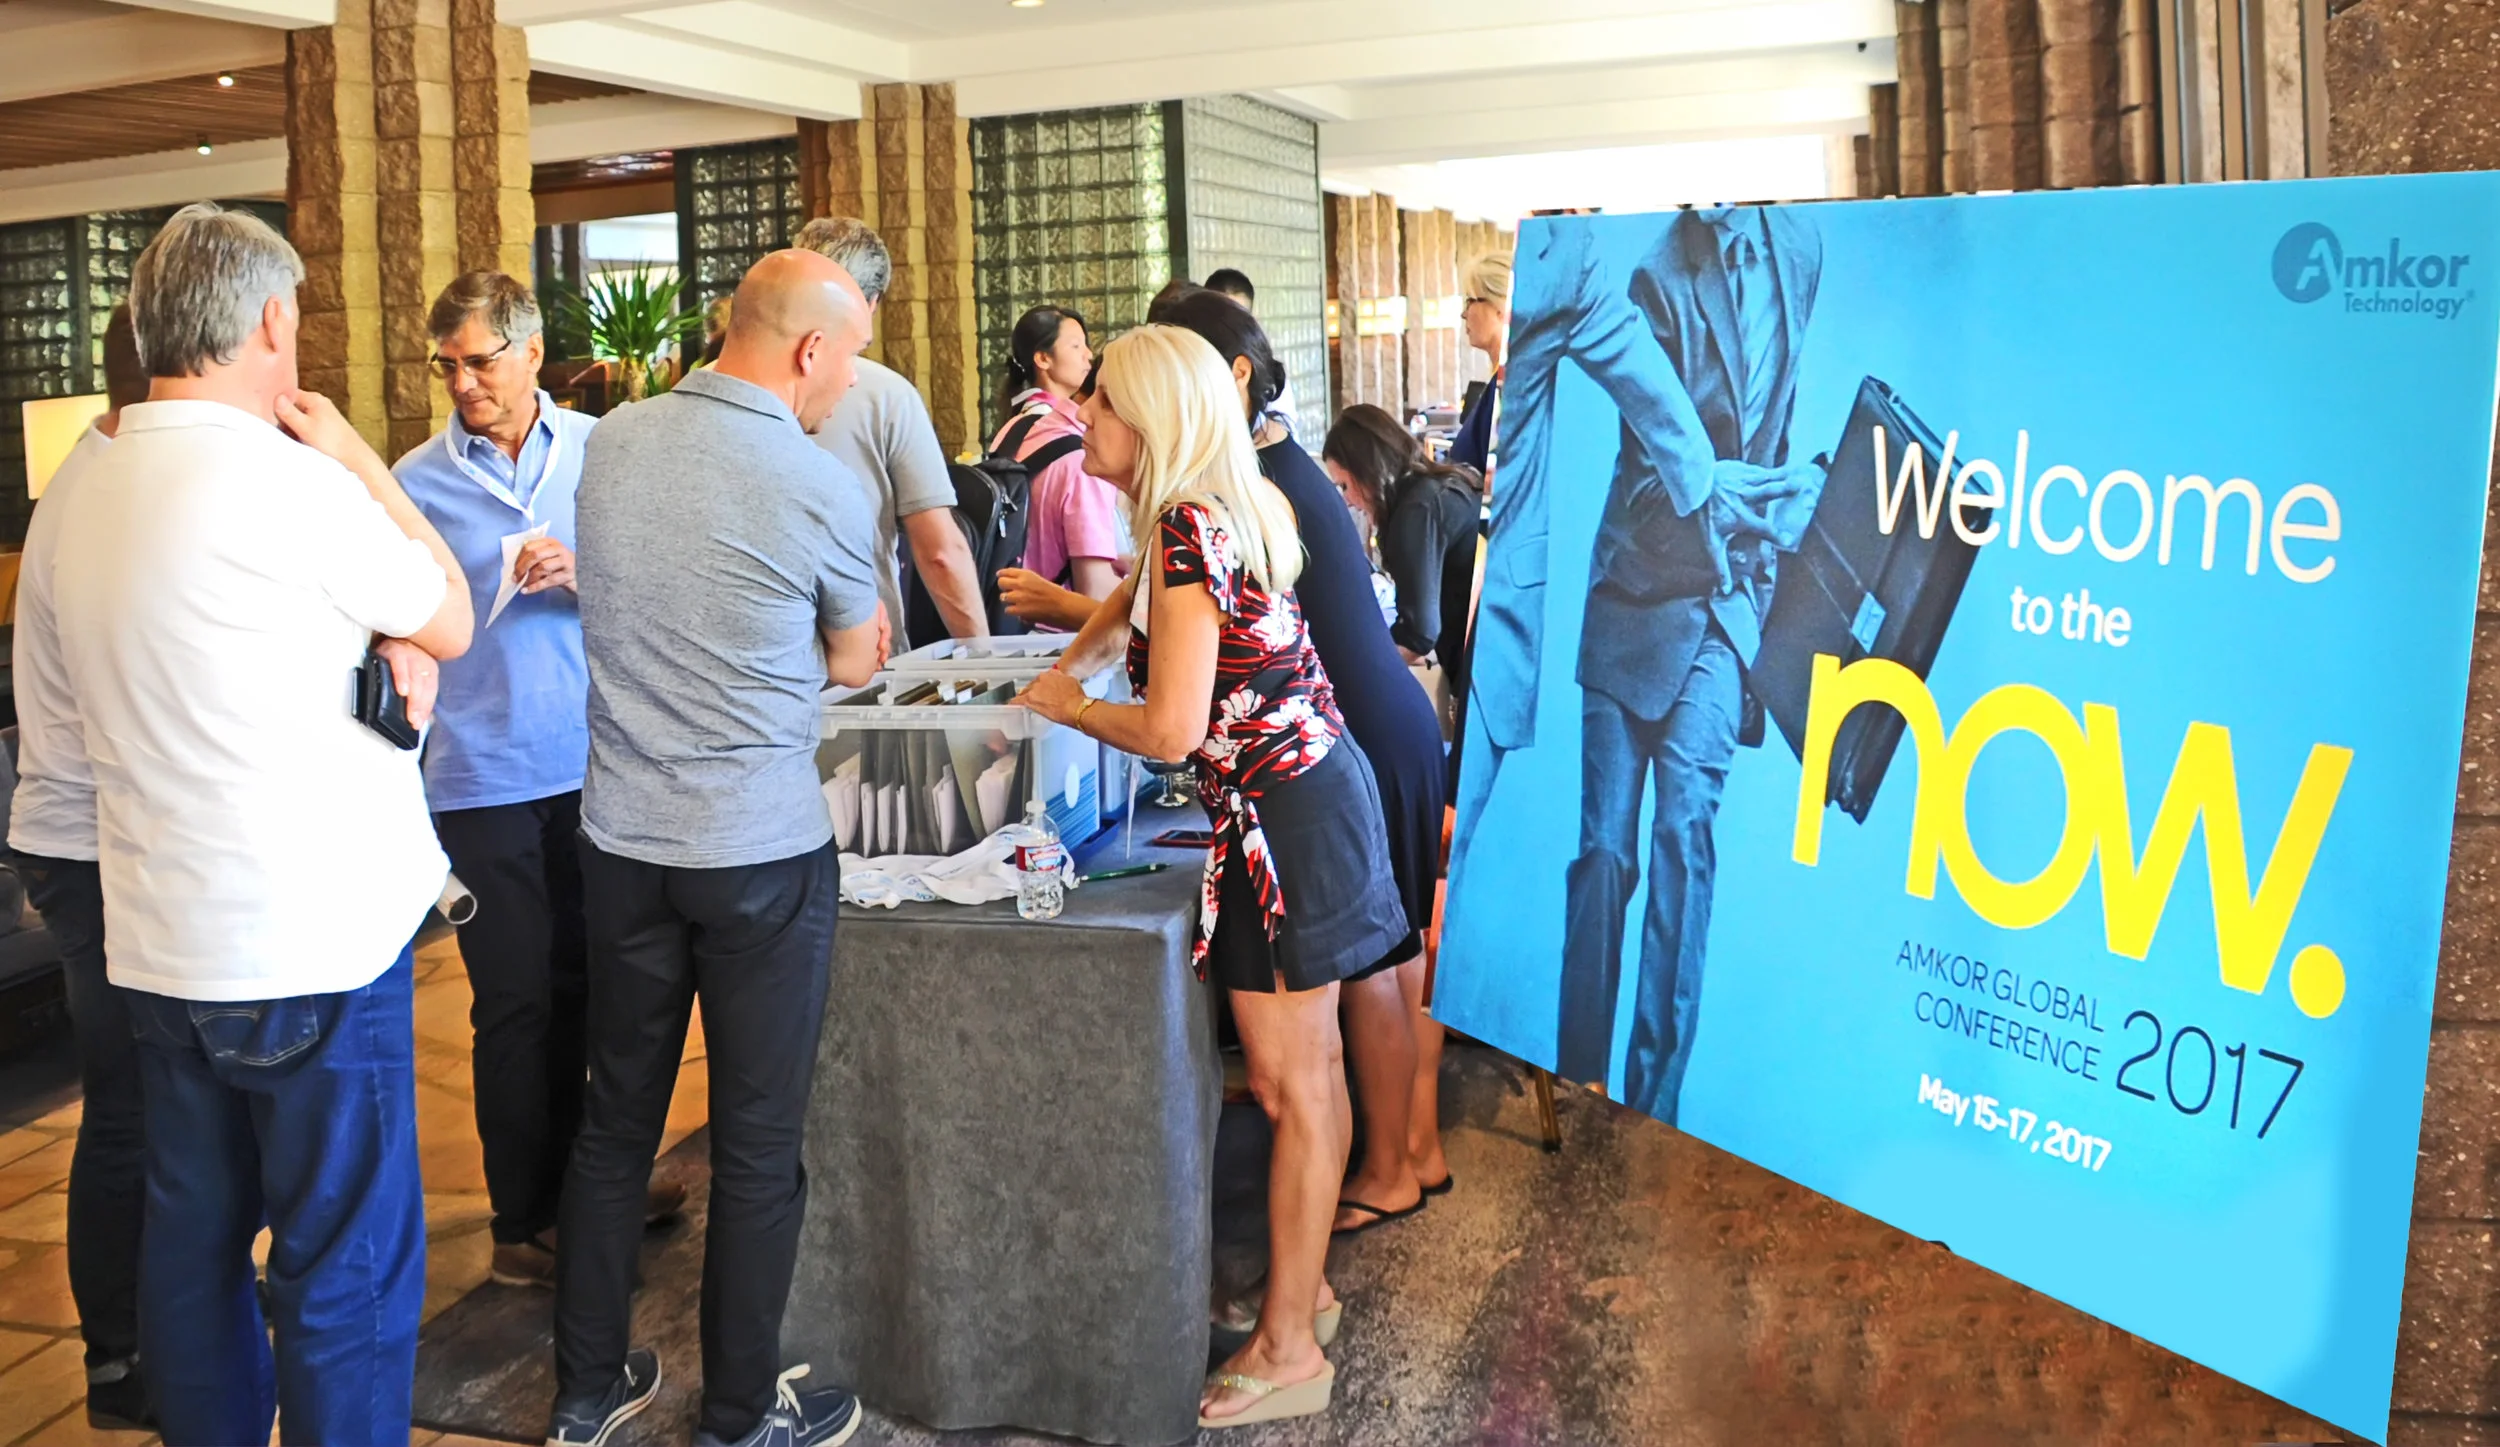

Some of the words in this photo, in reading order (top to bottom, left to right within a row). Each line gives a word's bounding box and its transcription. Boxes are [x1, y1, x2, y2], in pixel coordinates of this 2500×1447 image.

[2296, 236, 2470, 289] Amkor
[1873, 425, 2341, 583] Welcome
[2010, 585, 2053, 633] to
[2060, 588, 2132, 647] the
[1791, 652, 2355, 1019] now.
[1896, 939, 1989, 994] AMKOR
[1994, 969, 2104, 1033] GLOBAL
[1915, 991, 2101, 1081] CONFERENCE
[2116, 1010, 2304, 1139] 2017
[1918, 1073, 1970, 1127] May
